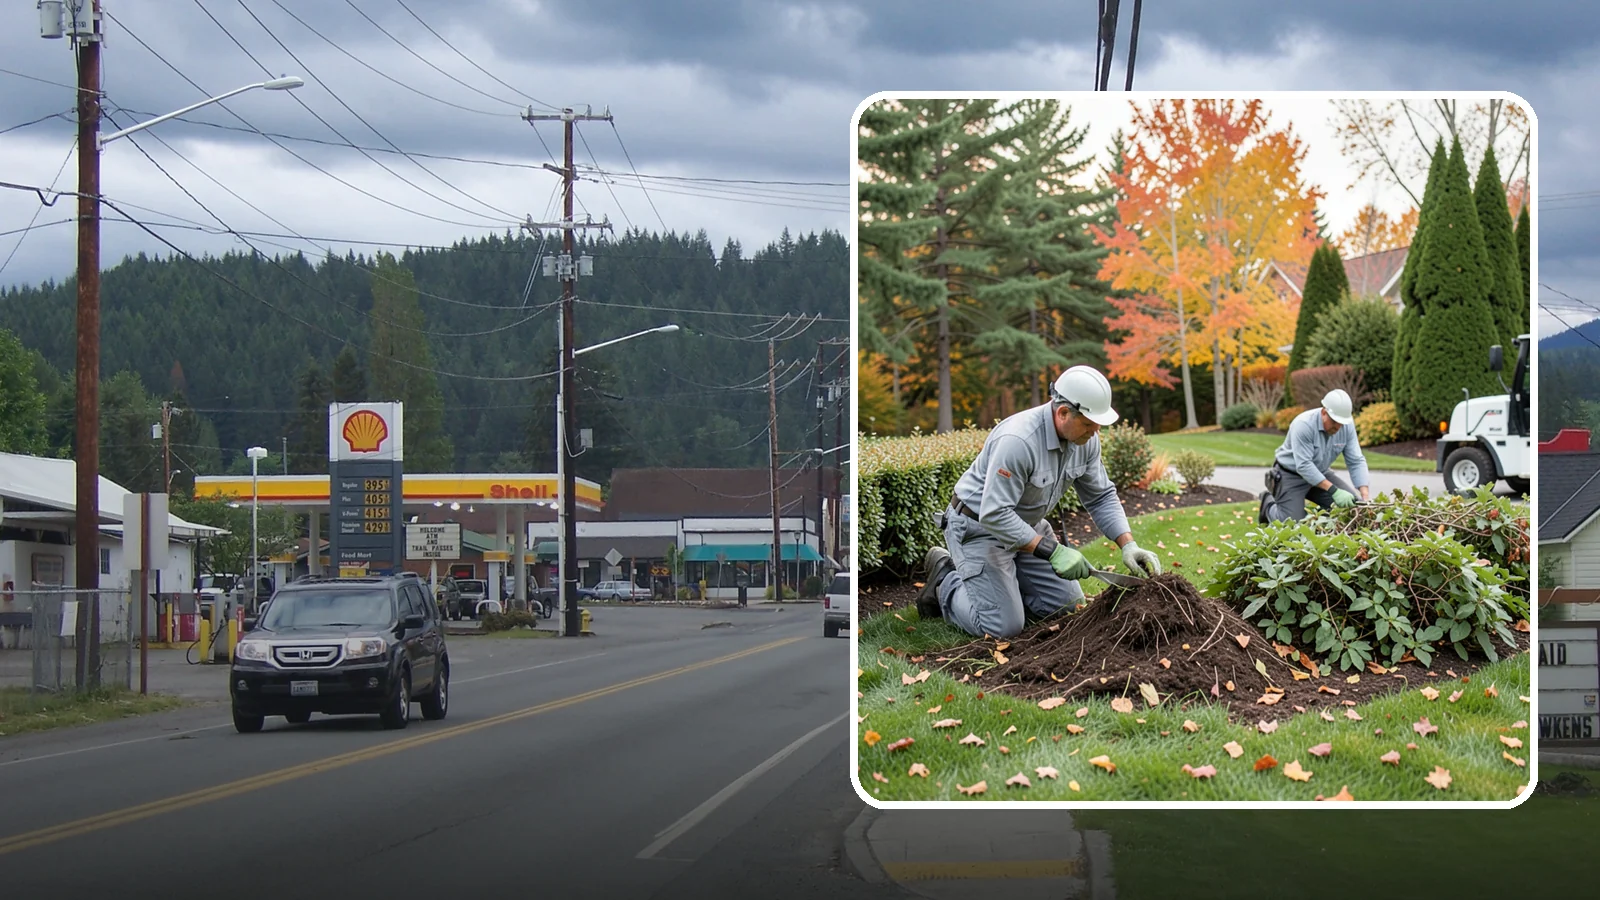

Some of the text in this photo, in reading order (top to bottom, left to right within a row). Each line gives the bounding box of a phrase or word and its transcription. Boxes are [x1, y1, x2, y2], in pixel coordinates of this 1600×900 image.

[366, 480, 383, 490] 395
[490, 484, 547, 499] Shell
[366, 494, 383, 504] 405
[366, 508, 383, 518] 415
[366, 522, 383, 532] 429
